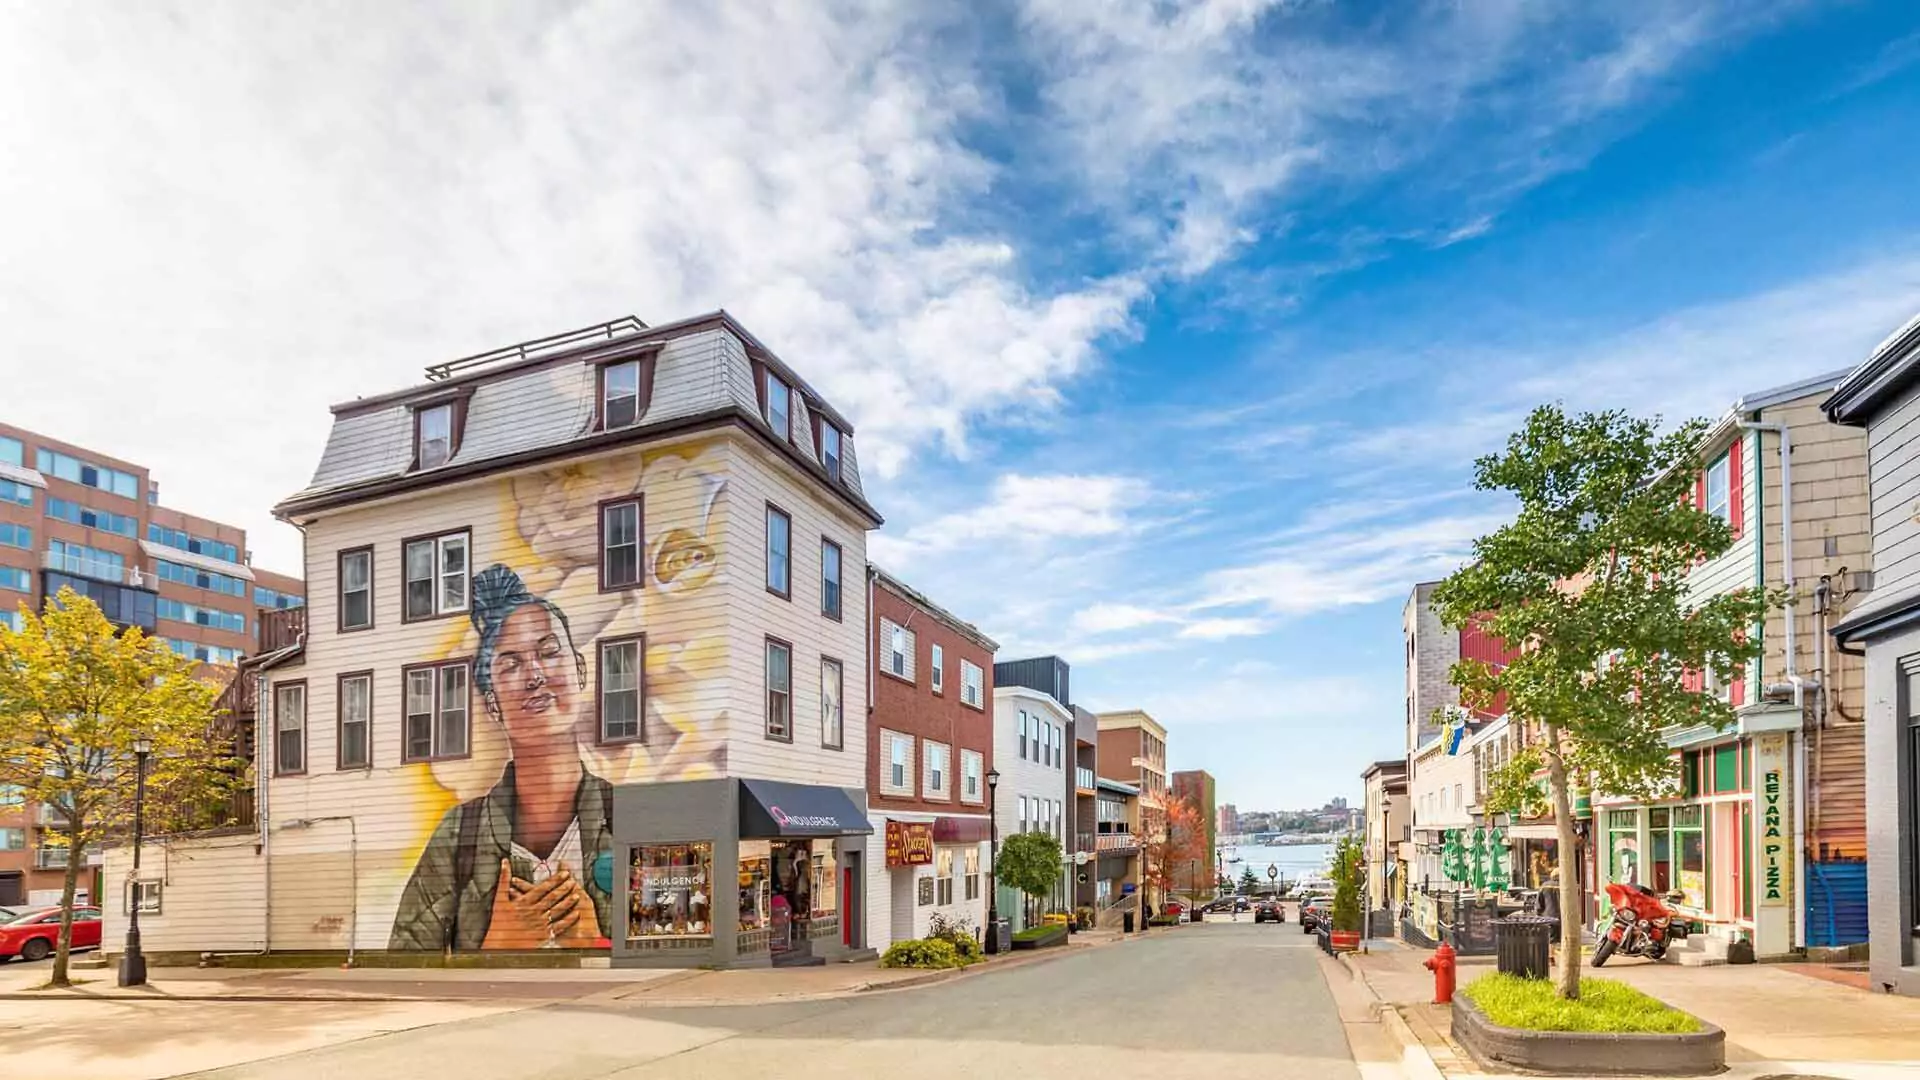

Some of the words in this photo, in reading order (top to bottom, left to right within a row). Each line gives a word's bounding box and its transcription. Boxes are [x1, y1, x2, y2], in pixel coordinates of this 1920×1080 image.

[786, 815, 839, 827] INDULGENCE
[1765, 773, 1780, 837] REVANA
[1766, 845, 1780, 899] PIZZA
